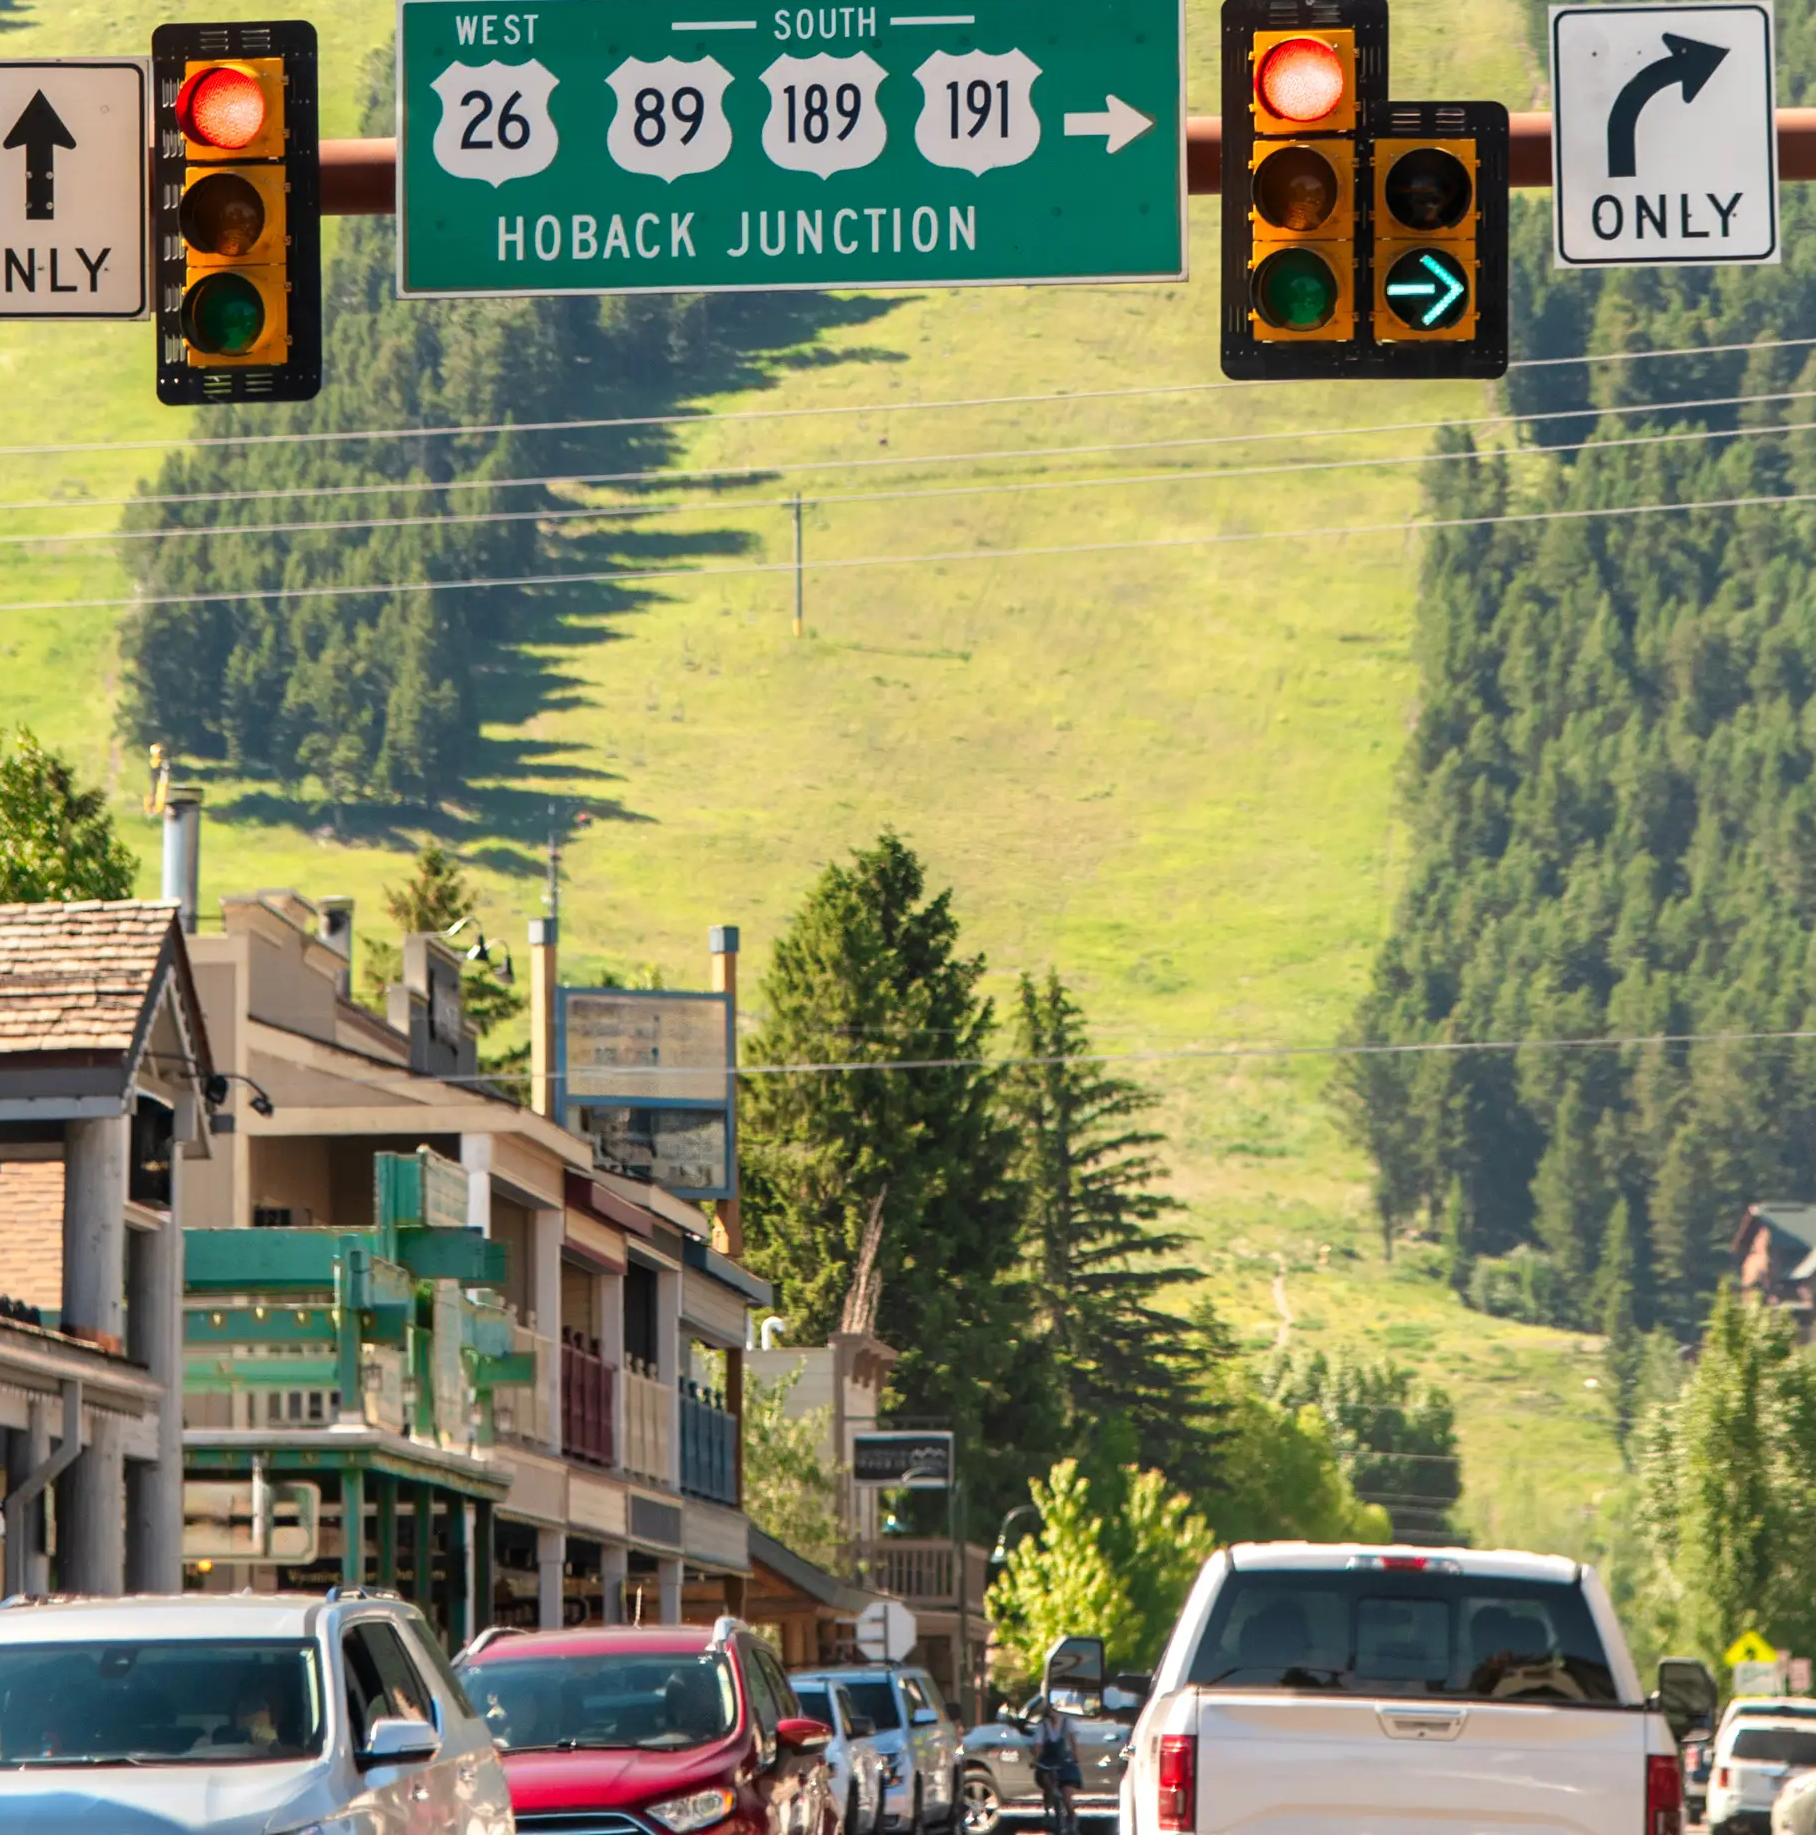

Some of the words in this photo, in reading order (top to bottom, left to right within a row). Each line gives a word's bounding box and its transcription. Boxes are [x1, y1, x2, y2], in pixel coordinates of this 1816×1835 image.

[456, 14, 539, 46] WEST
[774, 7, 876, 40] SOUTH
[460, 90, 531, 150] 26
[633, 87, 705, 147] 89
[783, 83, 862, 144] 189
[946, 80, 1009, 140] 191
[498, 212, 696, 261] HOBACK
[727, 206, 976, 258] JUNCTION
[1592, 192, 1743, 240] ONLY
